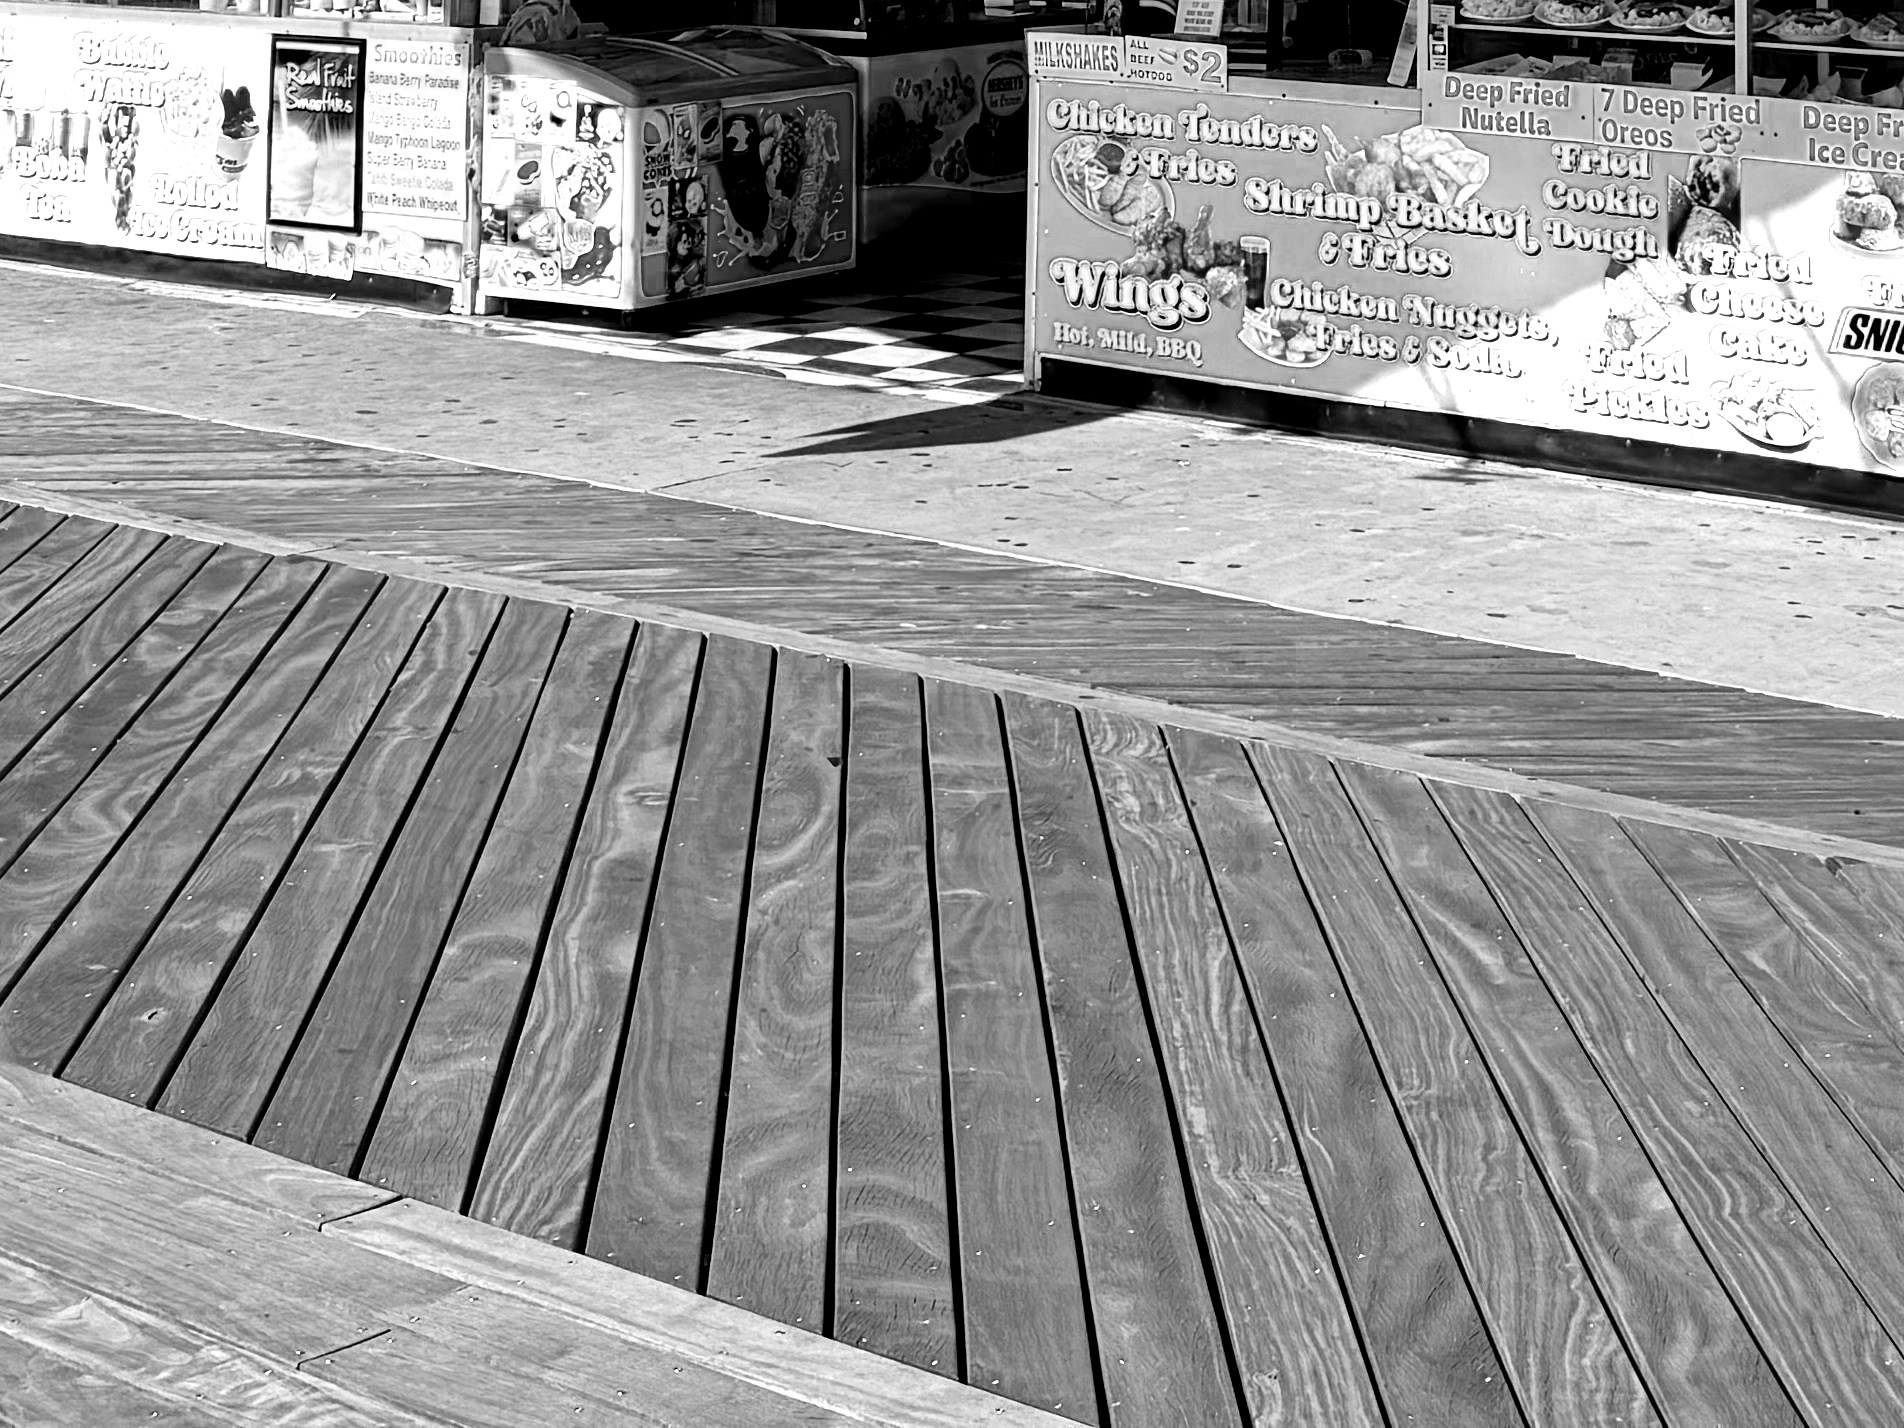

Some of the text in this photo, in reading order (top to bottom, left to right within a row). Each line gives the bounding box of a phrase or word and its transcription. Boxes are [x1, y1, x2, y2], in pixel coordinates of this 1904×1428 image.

[374, 44, 461, 66] Smoothies
[1033, 40, 1119, 73] MILKSHAKES
[1183, 47, 1222, 85] $2
[324, 63, 356, 88] Fruit
[1444, 75, 1570, 109] Deep Fried
[287, 87, 353, 113] Smoothies
[1601, 88, 1762, 126] 7 Deep Fried
[1046, 97, 1319, 153] Chicken Tenders
[1460, 105, 1552, 138] Nutella
[1600, 117, 1673, 148] Oreos
[1802, 106, 1869, 142] Deep
[1141, 147, 1239, 187] Fries
[1808, 136, 1846, 163] Ice
[1542, 180, 1661, 219] Cookie
[1244, 177, 1541, 258] Shrimp Basket
[1049, 257, 1212, 332] Wings
